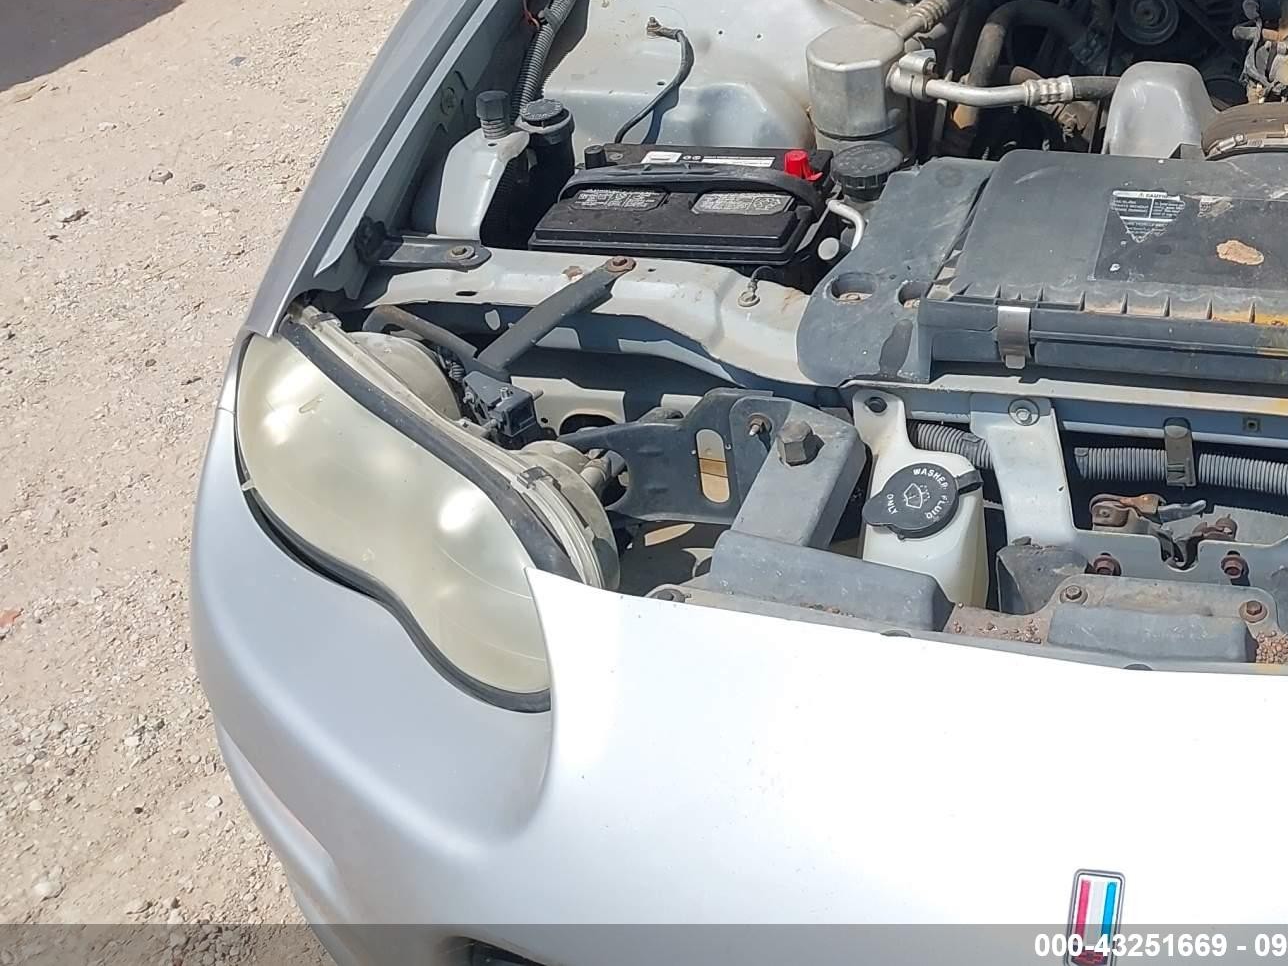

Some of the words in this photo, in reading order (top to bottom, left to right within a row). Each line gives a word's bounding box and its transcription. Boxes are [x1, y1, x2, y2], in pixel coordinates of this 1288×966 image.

[912, 467, 949, 490] WASHER
[886, 493, 898, 515] ONLY
[926, 494, 948, 520] FLUID
